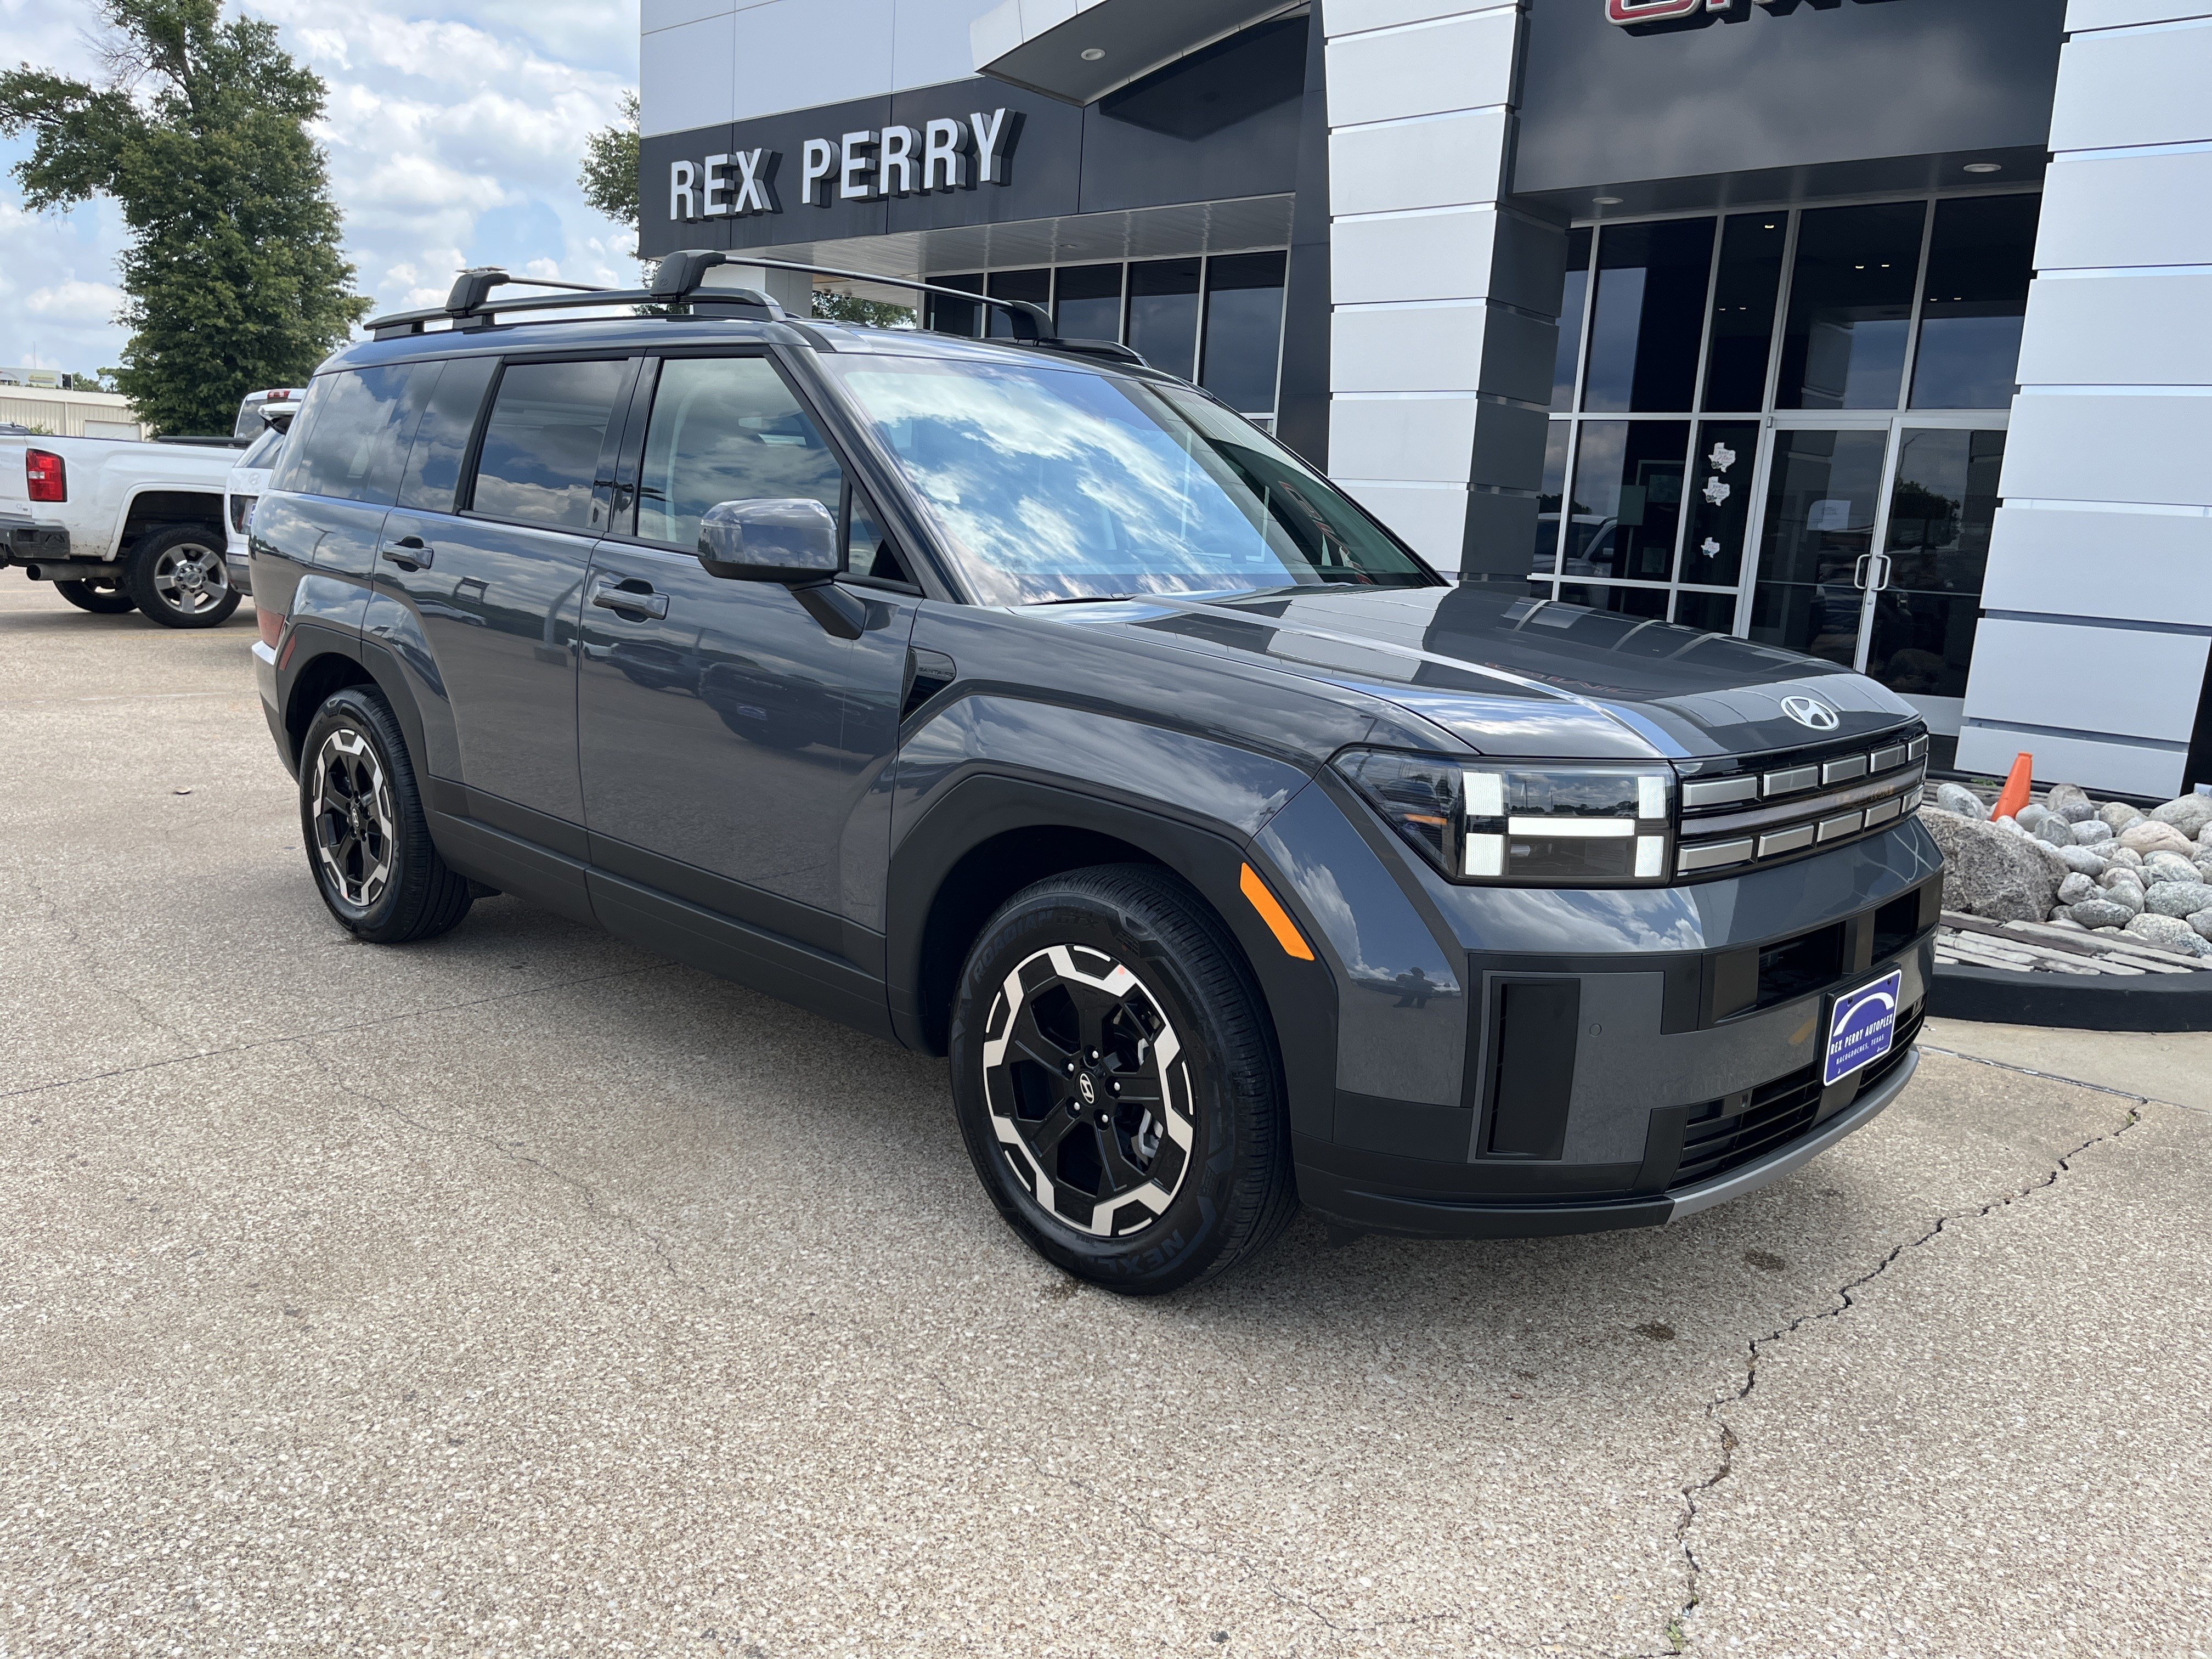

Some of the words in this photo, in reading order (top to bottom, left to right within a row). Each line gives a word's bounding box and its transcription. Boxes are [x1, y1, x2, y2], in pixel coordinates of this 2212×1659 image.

[670, 147, 772, 221] REX
[802, 108, 1015, 205] PERRY
[973, 910, 1053, 984] ROADIAN
[1830, 1039, 1843, 1055] REX
[1844, 1028, 1864, 1048] PERRY
[1864, 1013, 1893, 1037] AUTOPLEX
[1871, 1034, 1884, 1046] TEXAS
